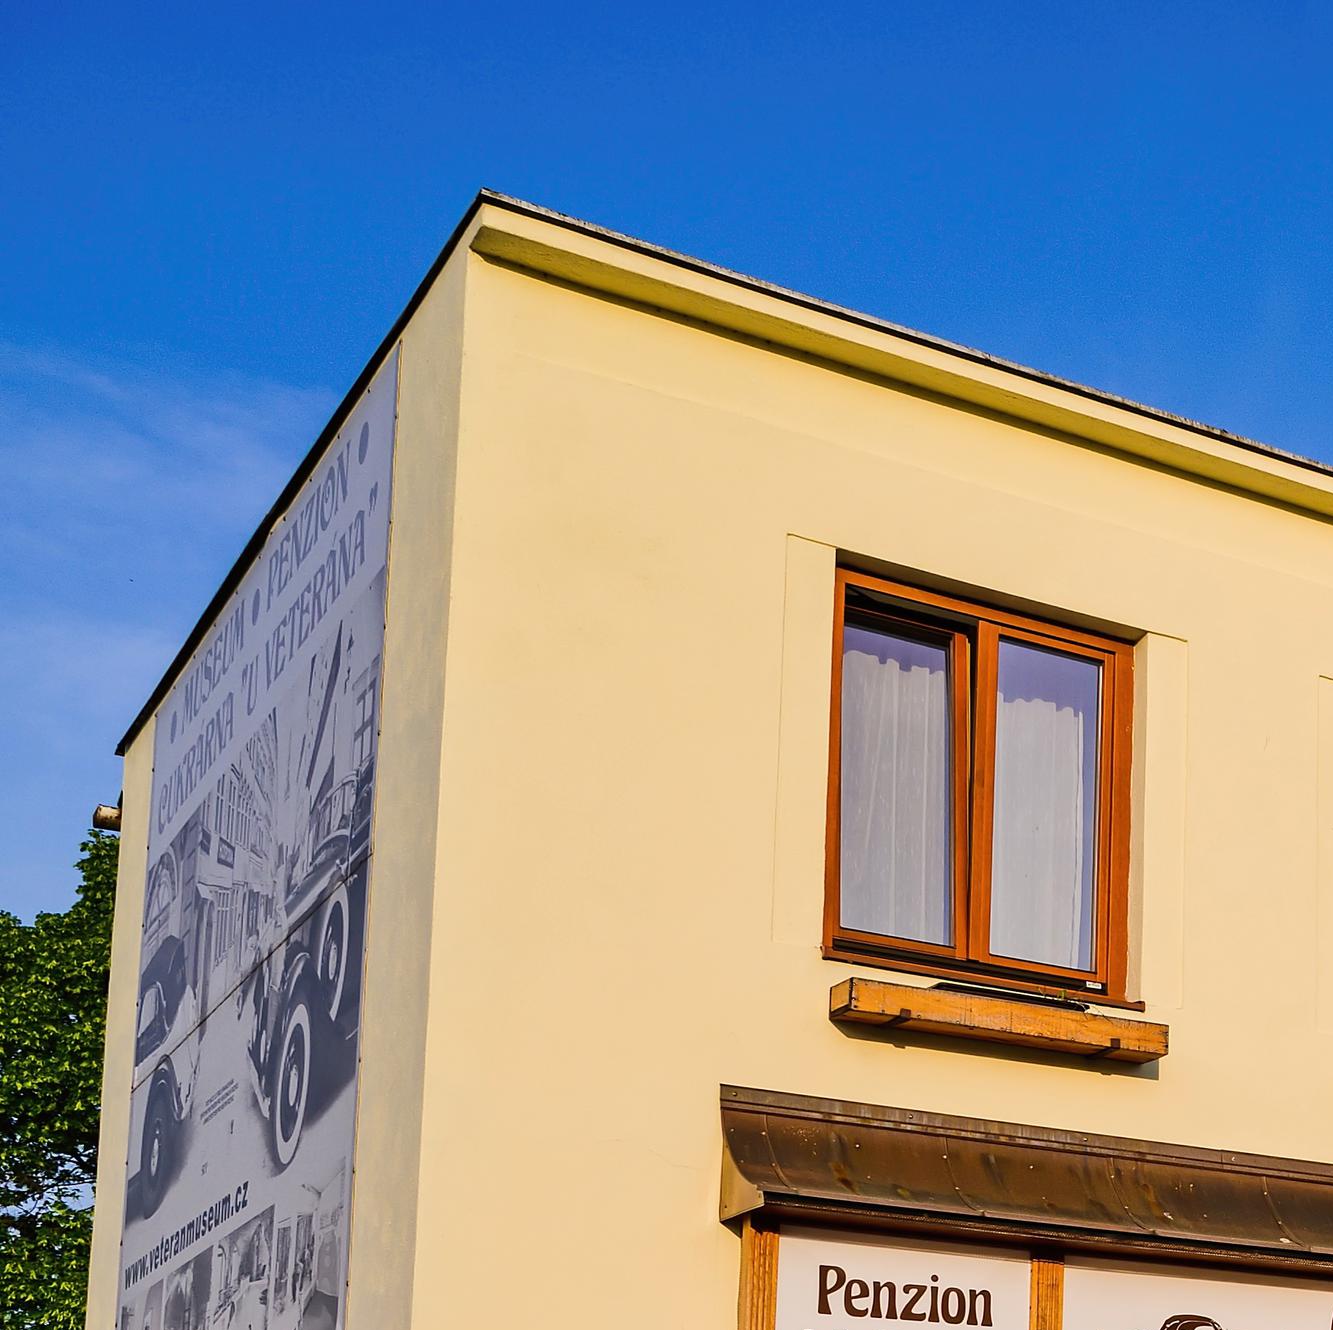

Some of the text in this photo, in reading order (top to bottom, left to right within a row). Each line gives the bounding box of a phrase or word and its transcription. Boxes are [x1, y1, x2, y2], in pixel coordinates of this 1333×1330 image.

[267, 440, 351, 612] PENZION
[125, 1181, 249, 1290] www.veteranmuseum.cz
[817, 1263, 993, 1327] Penzion
